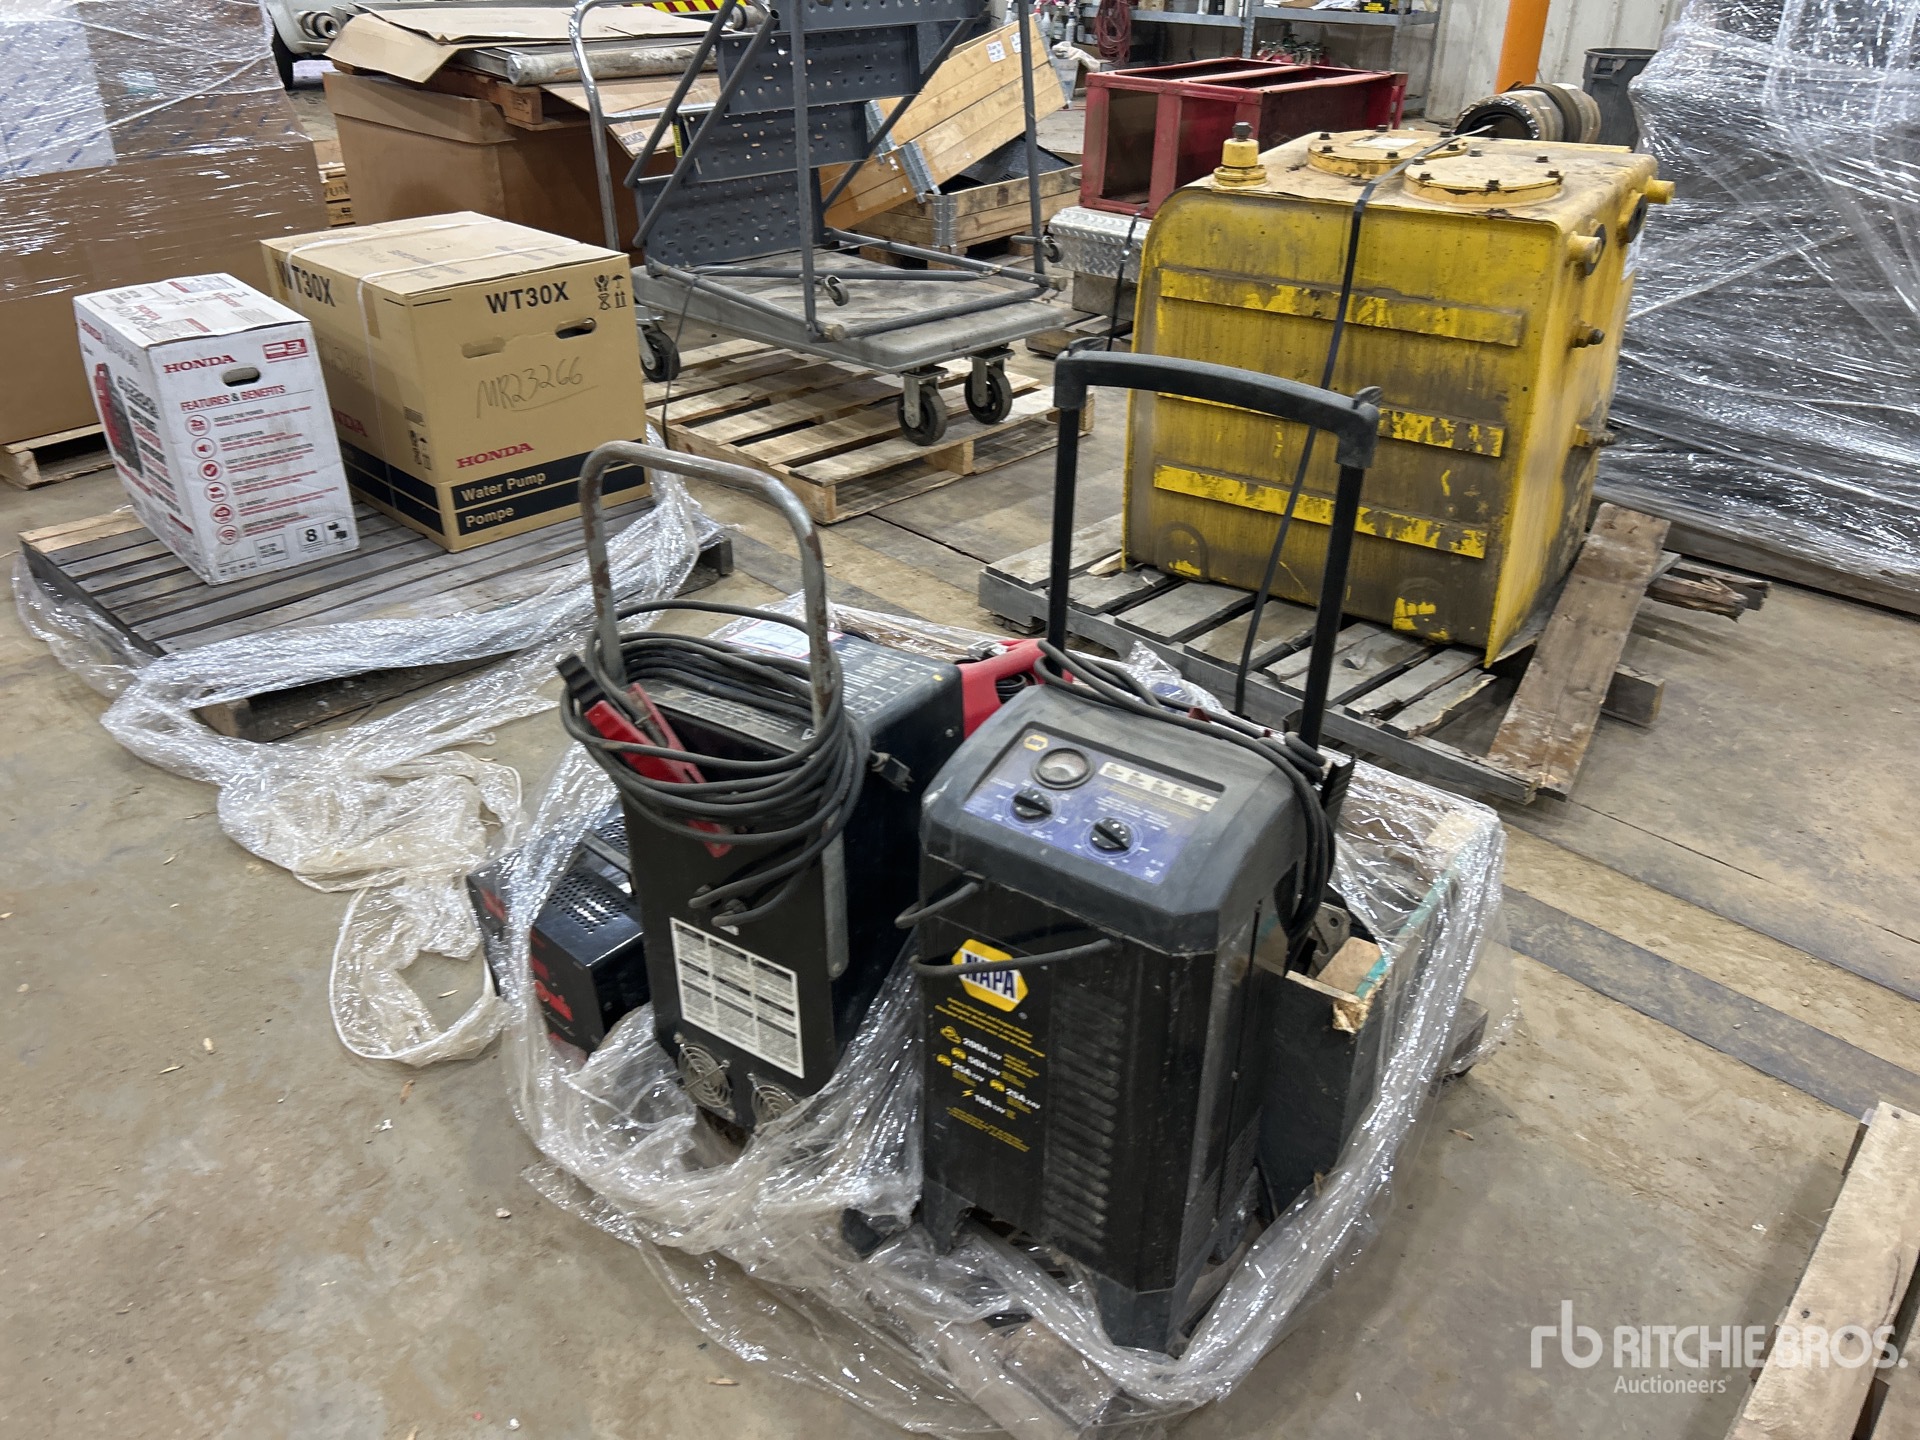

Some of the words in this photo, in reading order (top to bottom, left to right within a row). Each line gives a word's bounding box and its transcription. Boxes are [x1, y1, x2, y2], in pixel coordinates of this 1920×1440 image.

[486, 281, 570, 314] WT30X
[163, 354, 236, 374] HONDA
[180, 394, 230, 412] FEATURES
[232, 393, 240, 402] &
[241, 385, 287, 401] BENEFITS
[456, 442, 534, 469] HONDA
[461, 484, 503, 502] Water
[506, 472, 546, 491] Pump
[465, 506, 515, 528] Pompe
[305, 528, 318, 543] 8
[965, 953, 1015, 999] NAPA
